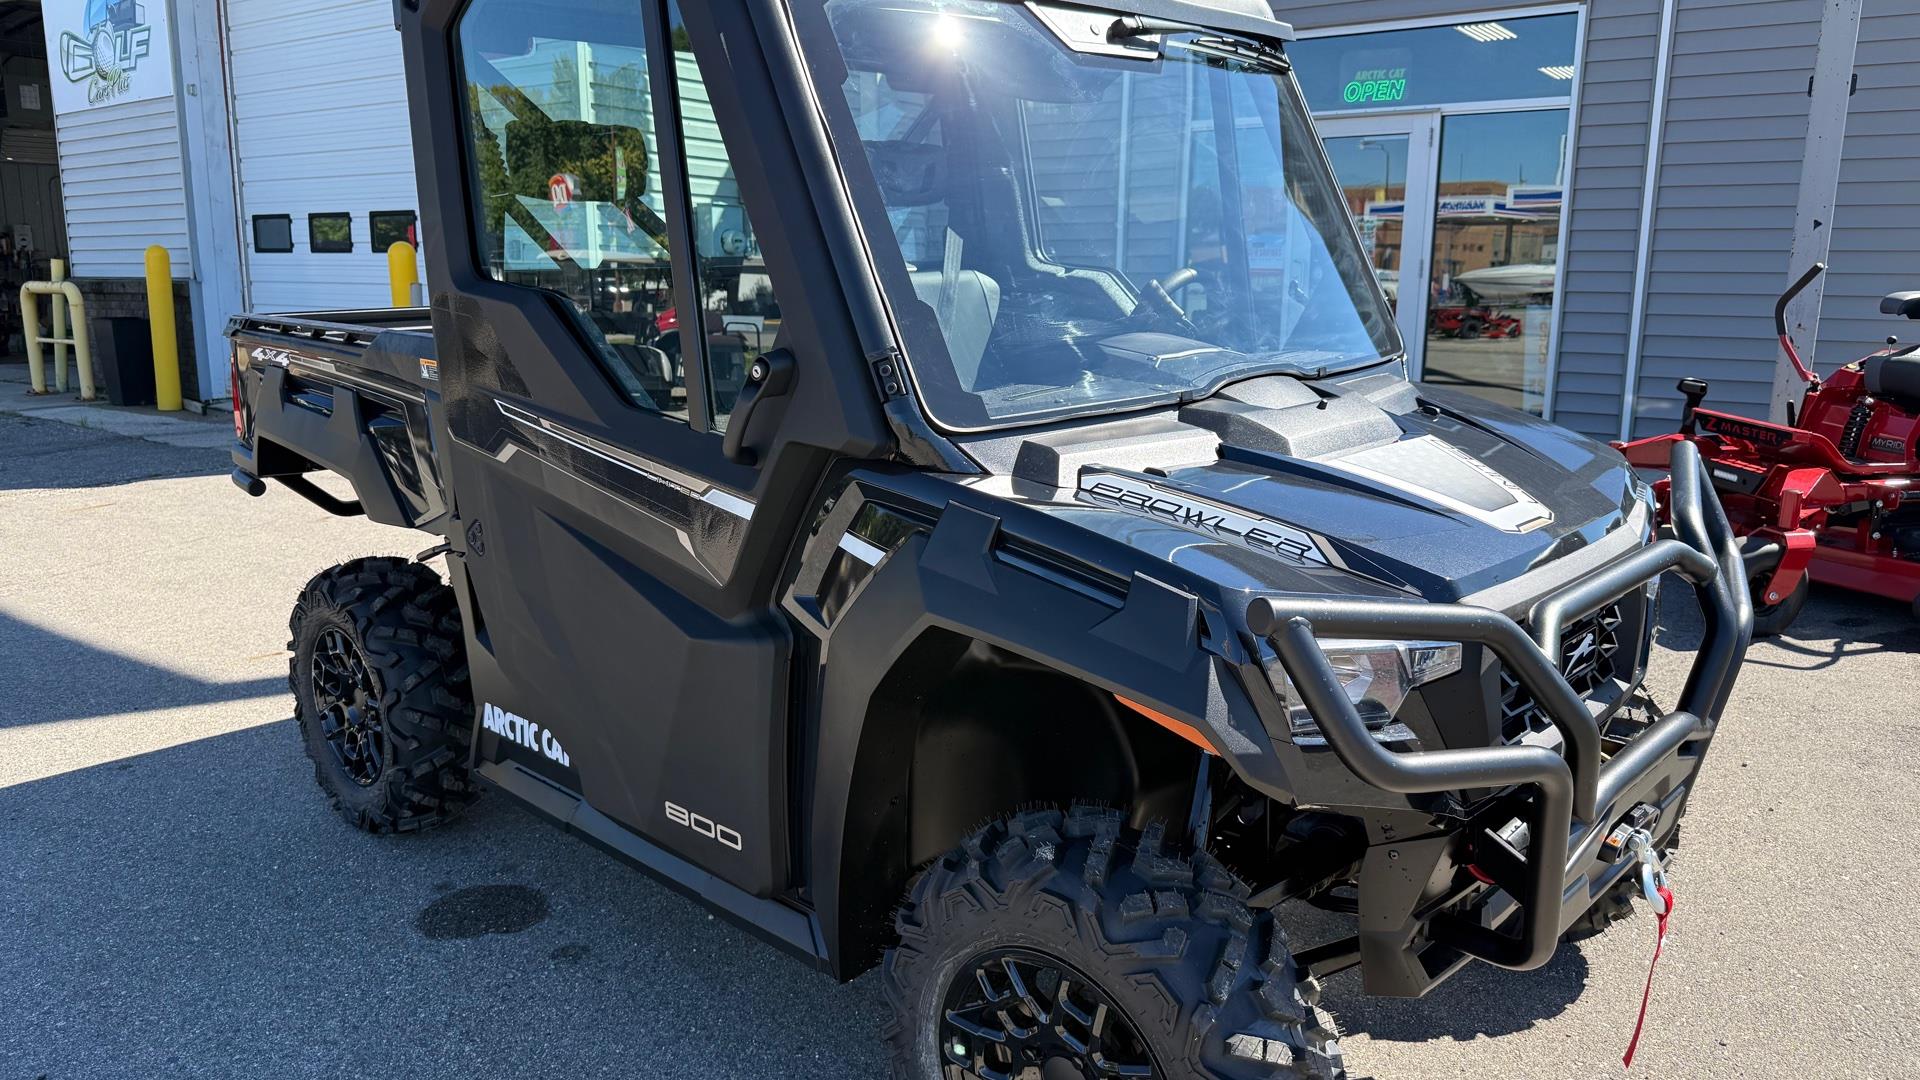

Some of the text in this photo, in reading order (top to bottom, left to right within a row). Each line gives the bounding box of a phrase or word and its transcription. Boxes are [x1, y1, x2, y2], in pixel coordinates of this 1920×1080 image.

[60, 24, 151, 83] GOLF
[1354, 68, 1406, 81] ARCTIC CAT
[1343, 79, 1405, 102] OPEN
[1705, 416, 1777, 445] Z MASTER
[1088, 482, 1313, 561] PROWLER
[483, 702, 539, 752] ARCTIC
[664, 800, 743, 851] 800
